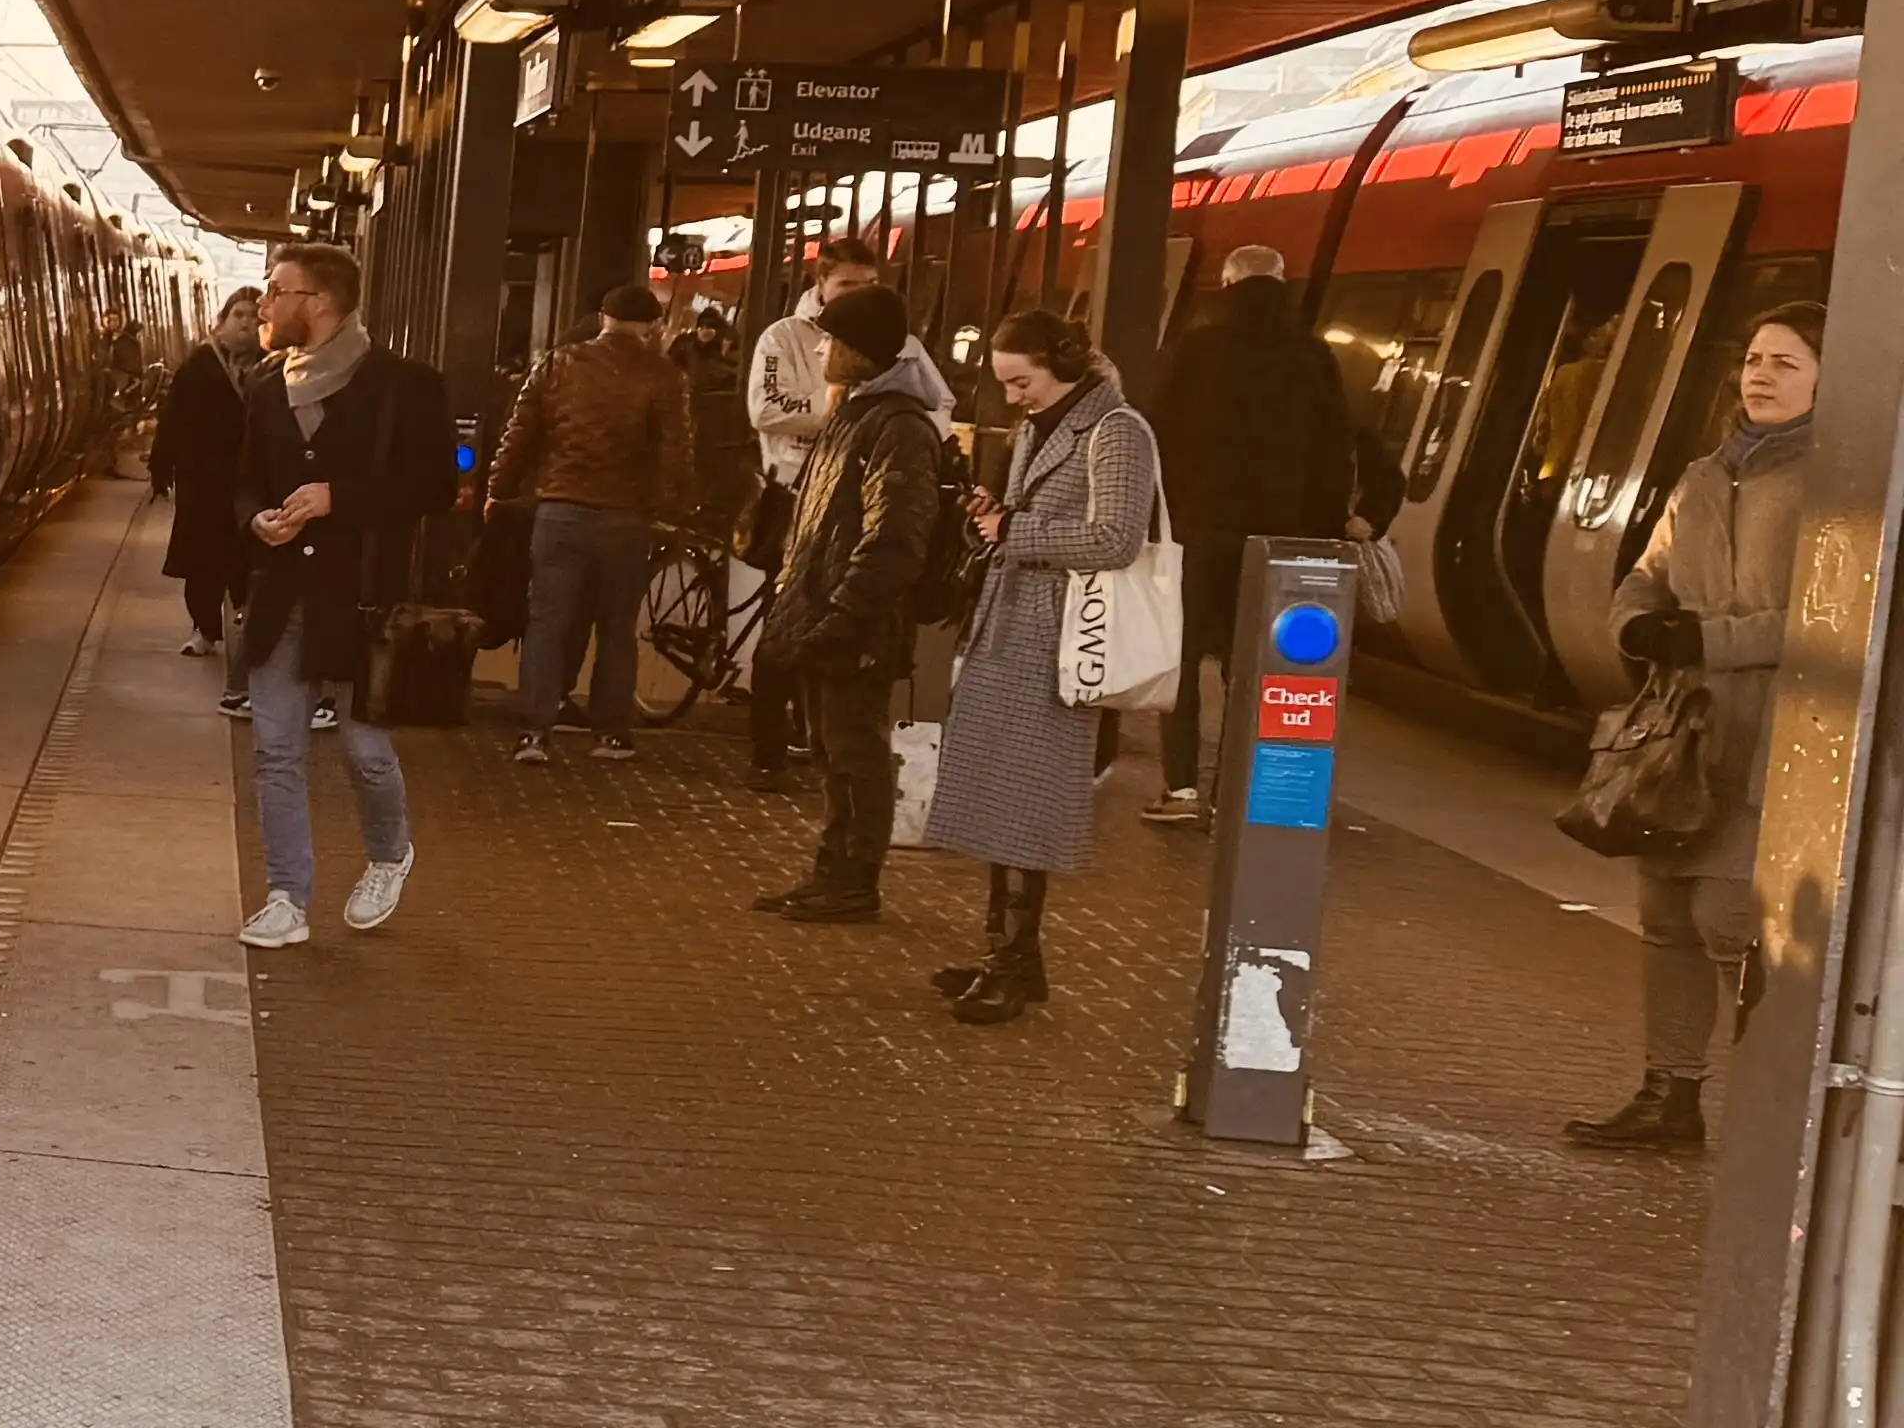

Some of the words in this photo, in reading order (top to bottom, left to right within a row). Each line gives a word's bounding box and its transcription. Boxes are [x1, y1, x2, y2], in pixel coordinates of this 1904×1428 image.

[796, 81, 880, 99] Elevator
[793, 122, 871, 143] Udgang
[792, 143, 817, 156] Exit
[1263, 687, 1335, 707] Check
[1282, 709, 1311, 726] ud
